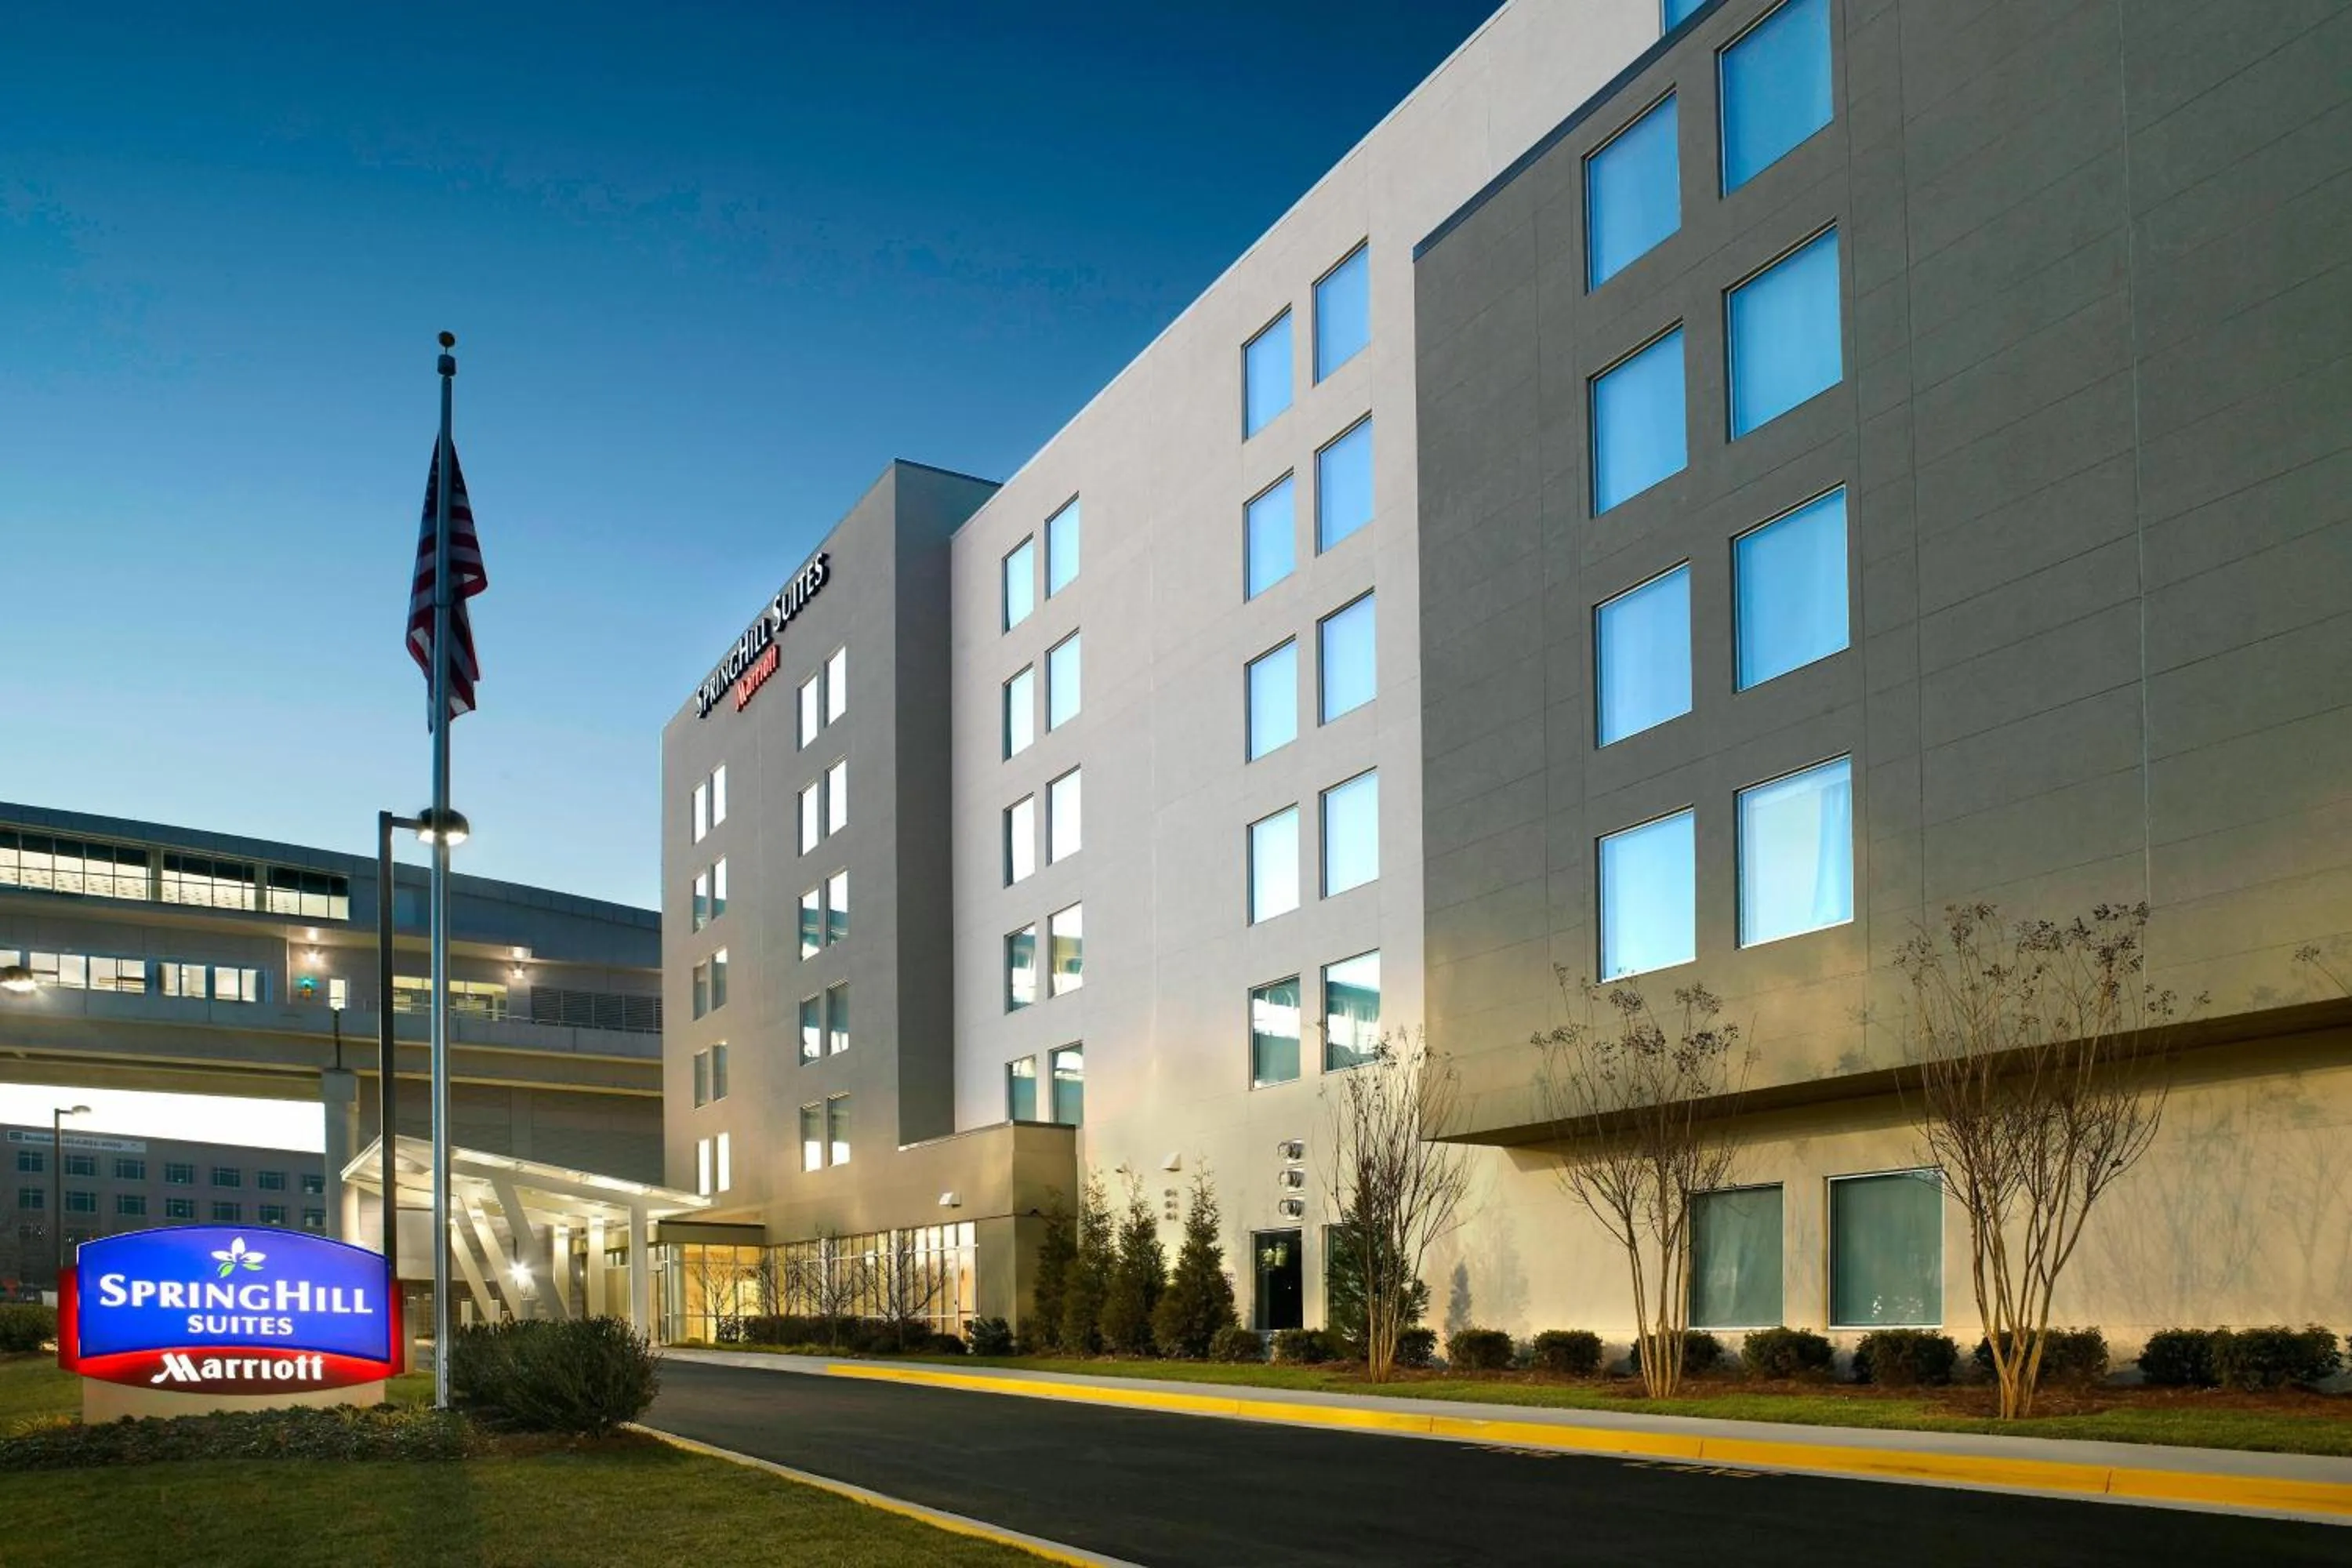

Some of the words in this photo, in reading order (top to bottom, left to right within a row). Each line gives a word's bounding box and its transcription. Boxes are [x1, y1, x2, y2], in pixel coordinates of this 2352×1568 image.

[696, 618, 773, 719] SPRINGHILL
[772, 552, 830, 632] SUITES
[734, 644, 780, 713] Marriott
[100, 1273, 373, 1314] SPRINGHILL
[188, 1315, 294, 1335] SUITES
[151, 1352, 325, 1384] Marriott
